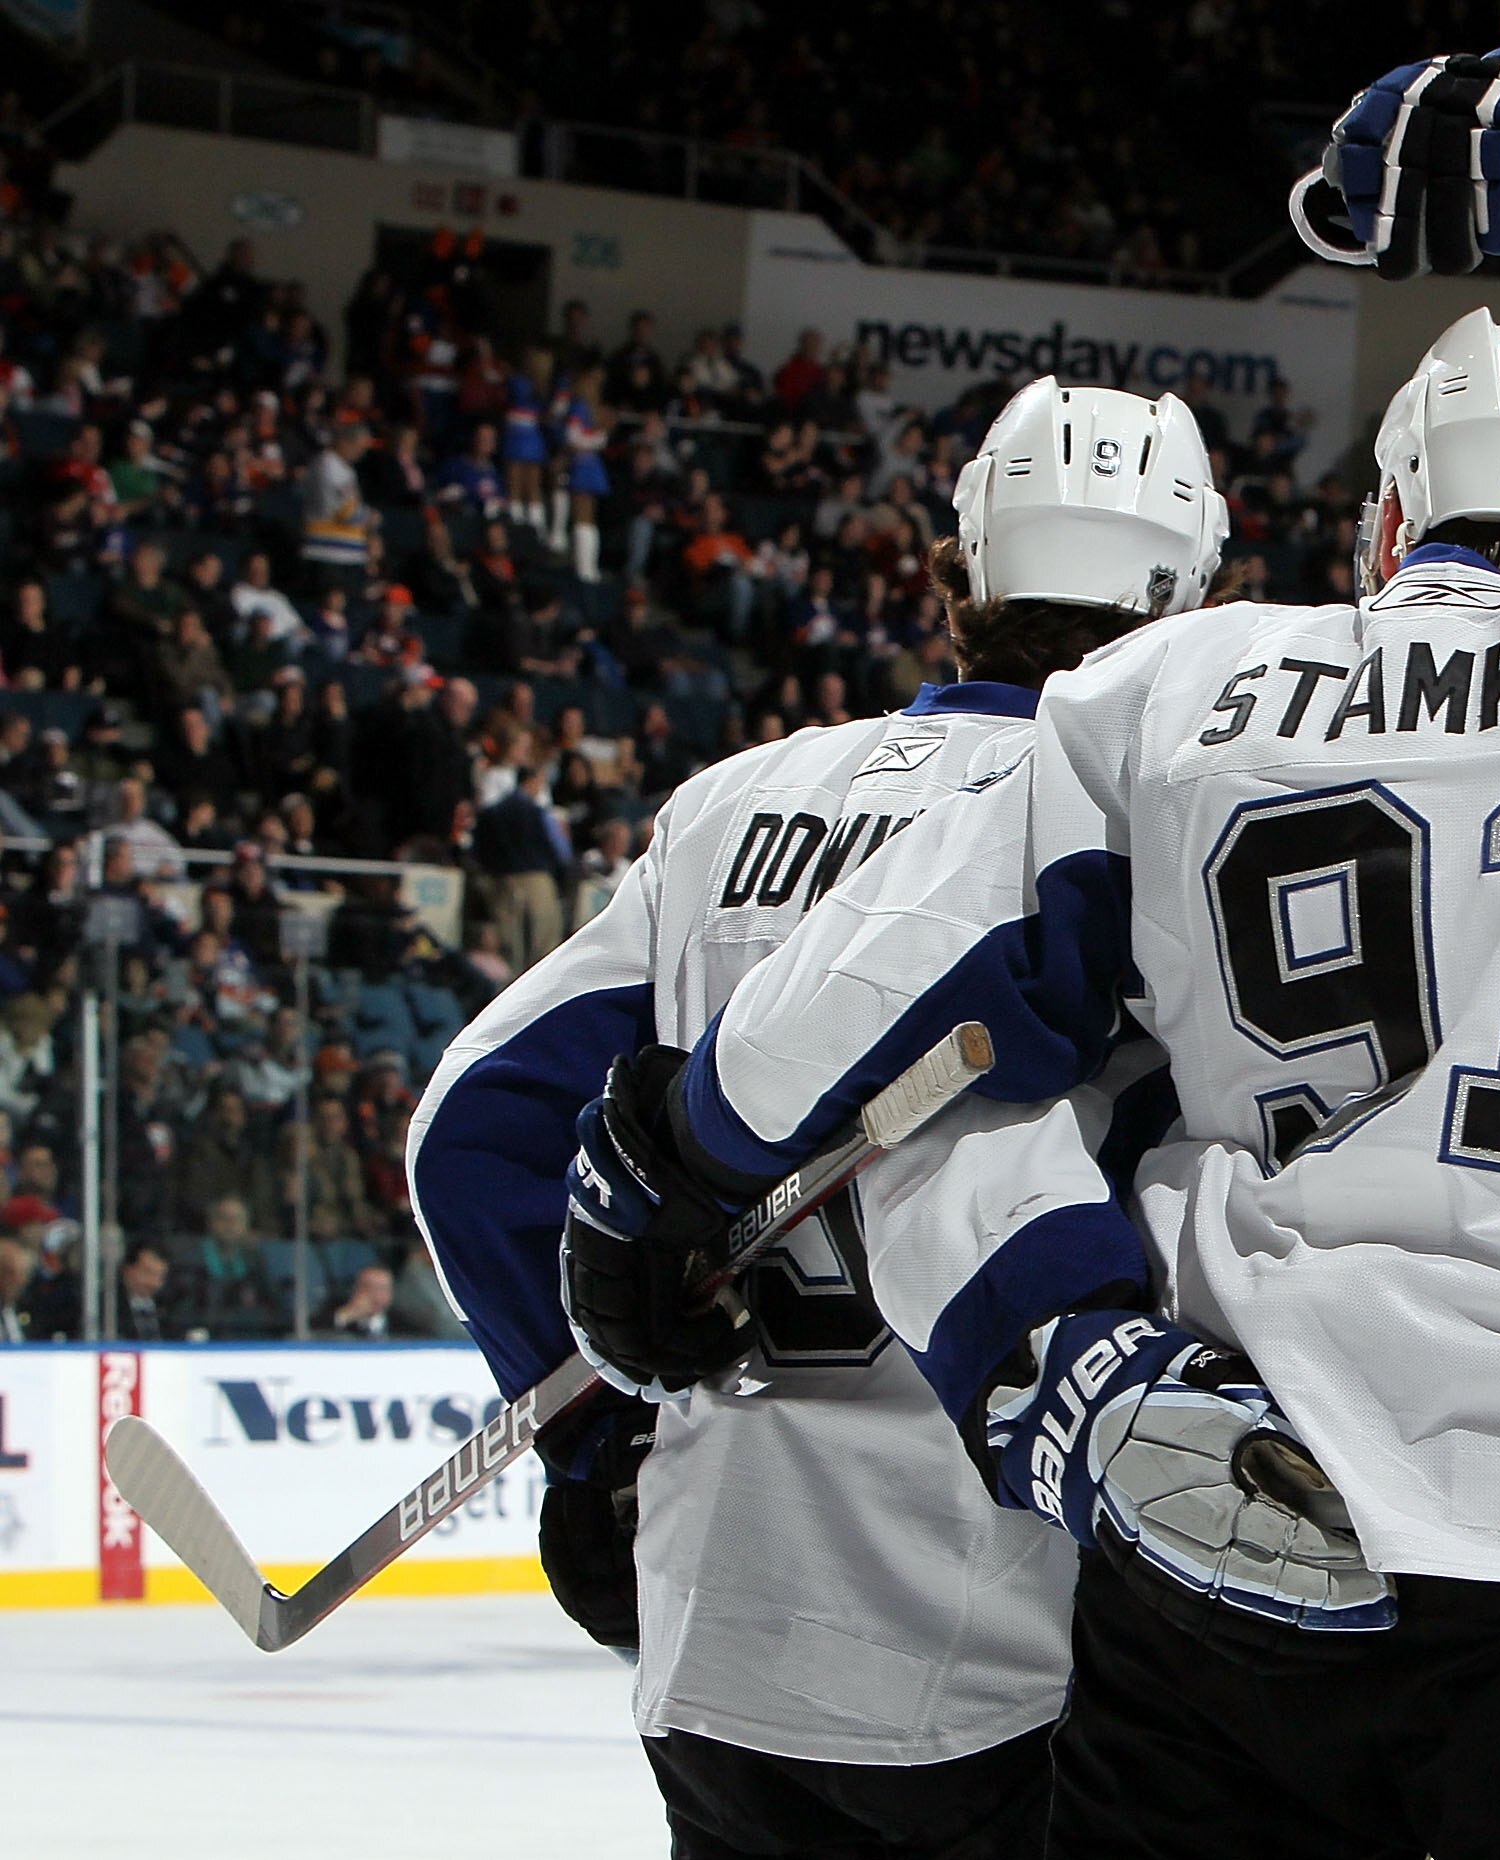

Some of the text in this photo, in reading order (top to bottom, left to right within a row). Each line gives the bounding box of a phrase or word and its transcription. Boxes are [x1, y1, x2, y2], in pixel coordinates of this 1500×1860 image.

[1091, 438, 1122, 478] 9
[728, 1171, 802, 1255] BAUER
[102, 1353, 138, 1549] Reok
[1031, 1314, 1166, 1525] BAUER
